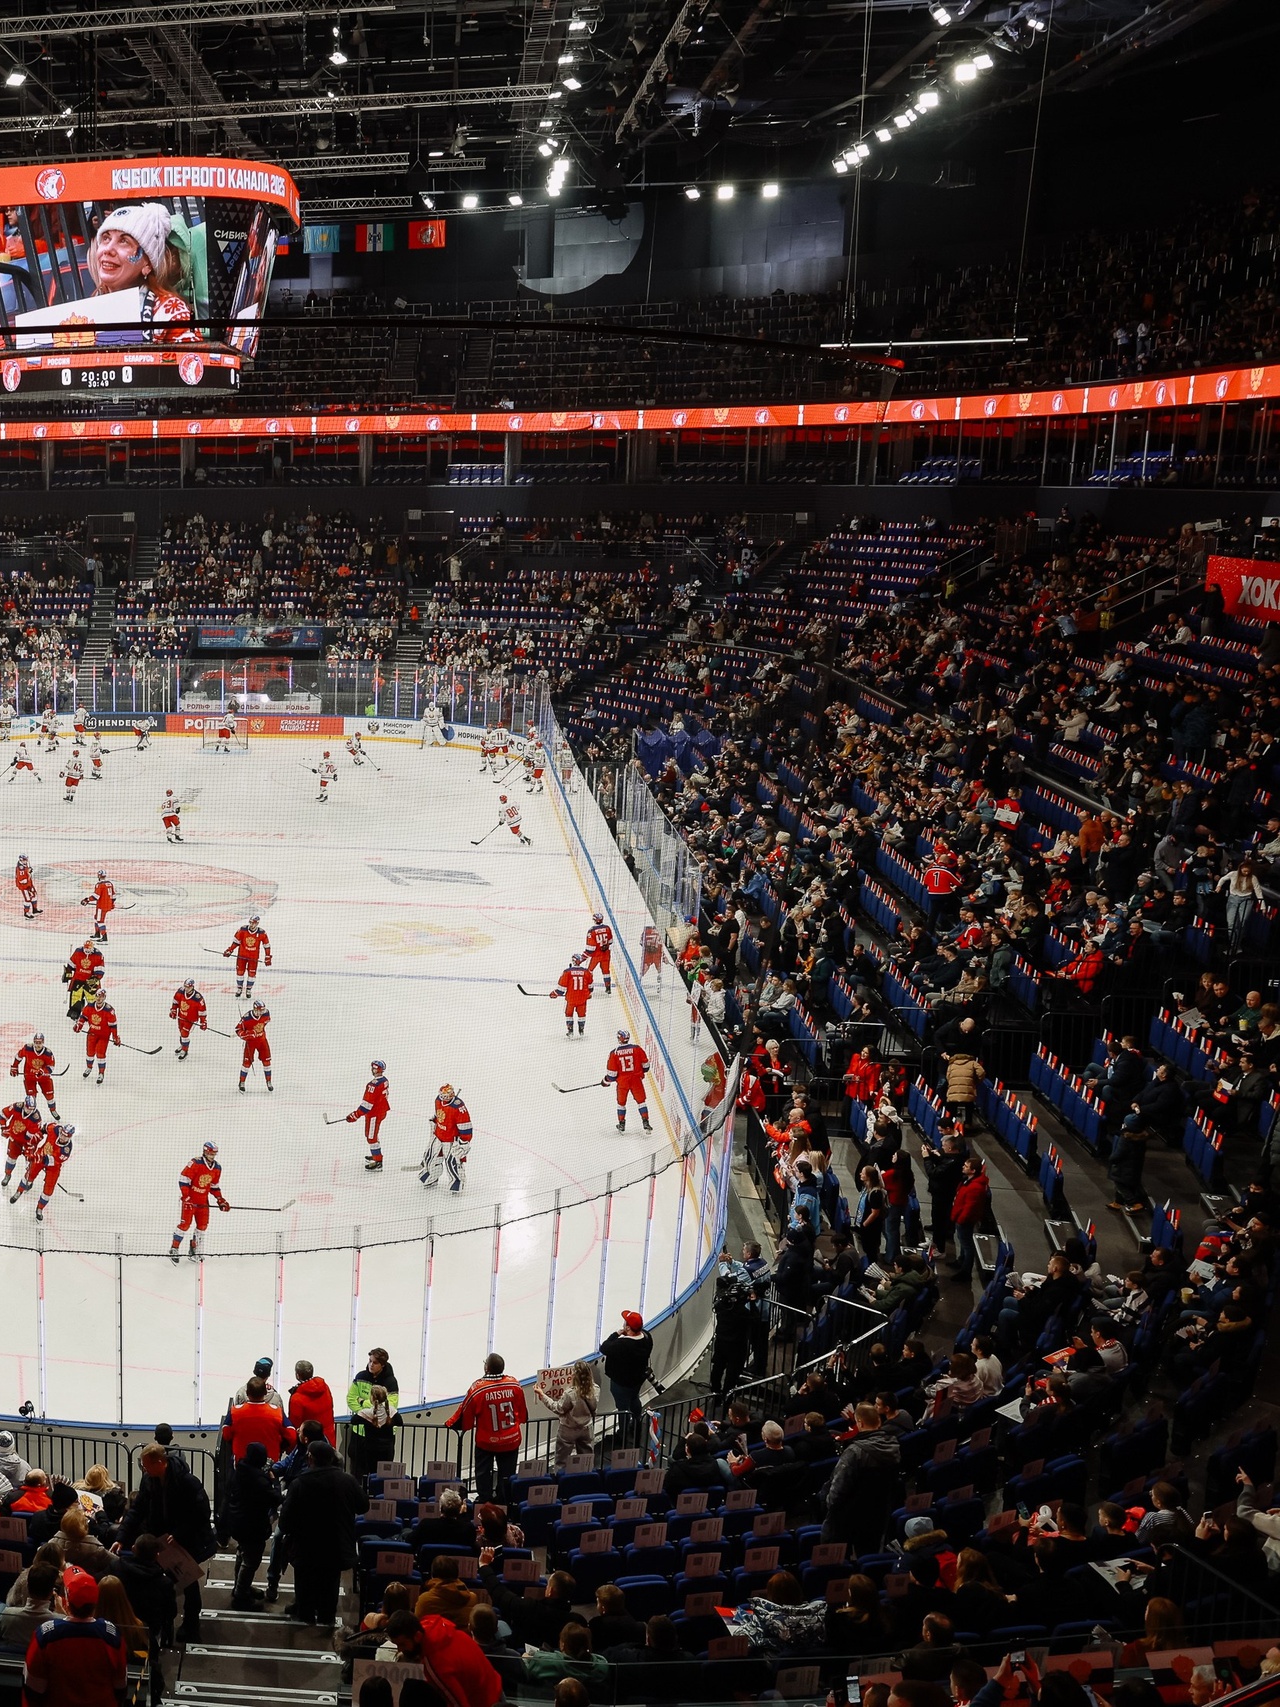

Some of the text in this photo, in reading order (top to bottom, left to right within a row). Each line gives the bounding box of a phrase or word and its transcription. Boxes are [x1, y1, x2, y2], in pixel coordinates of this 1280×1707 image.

[112, 166, 286, 197] КУБОК ПЕРВОГО КАНАЛА 2025
[214, 230, 248, 240] СИБИРЬ
[47, 357, 70, 366] РОССИЯ
[124, 354, 154, 363] БЕЛАРУСЬ
[62, 366, 133, 386] 0 20:00 0
[88, 380, 109, 388] 30:49
[1238, 575, 1280, 610] ХОК
[98, 719, 158, 727] HENDERN
[932, 872, 940, 886] 1
[595, 933, 608, 946] 45
[572, 977, 584, 991] 11
[619, 1056, 634, 1072] 13
[541, 1368, 573, 1380] РОССИ
[552, 1377, 572, 1387] МОЕ
[485, 1388, 515, 1401] DATSYUK
[489, 1401, 516, 1432] 13
